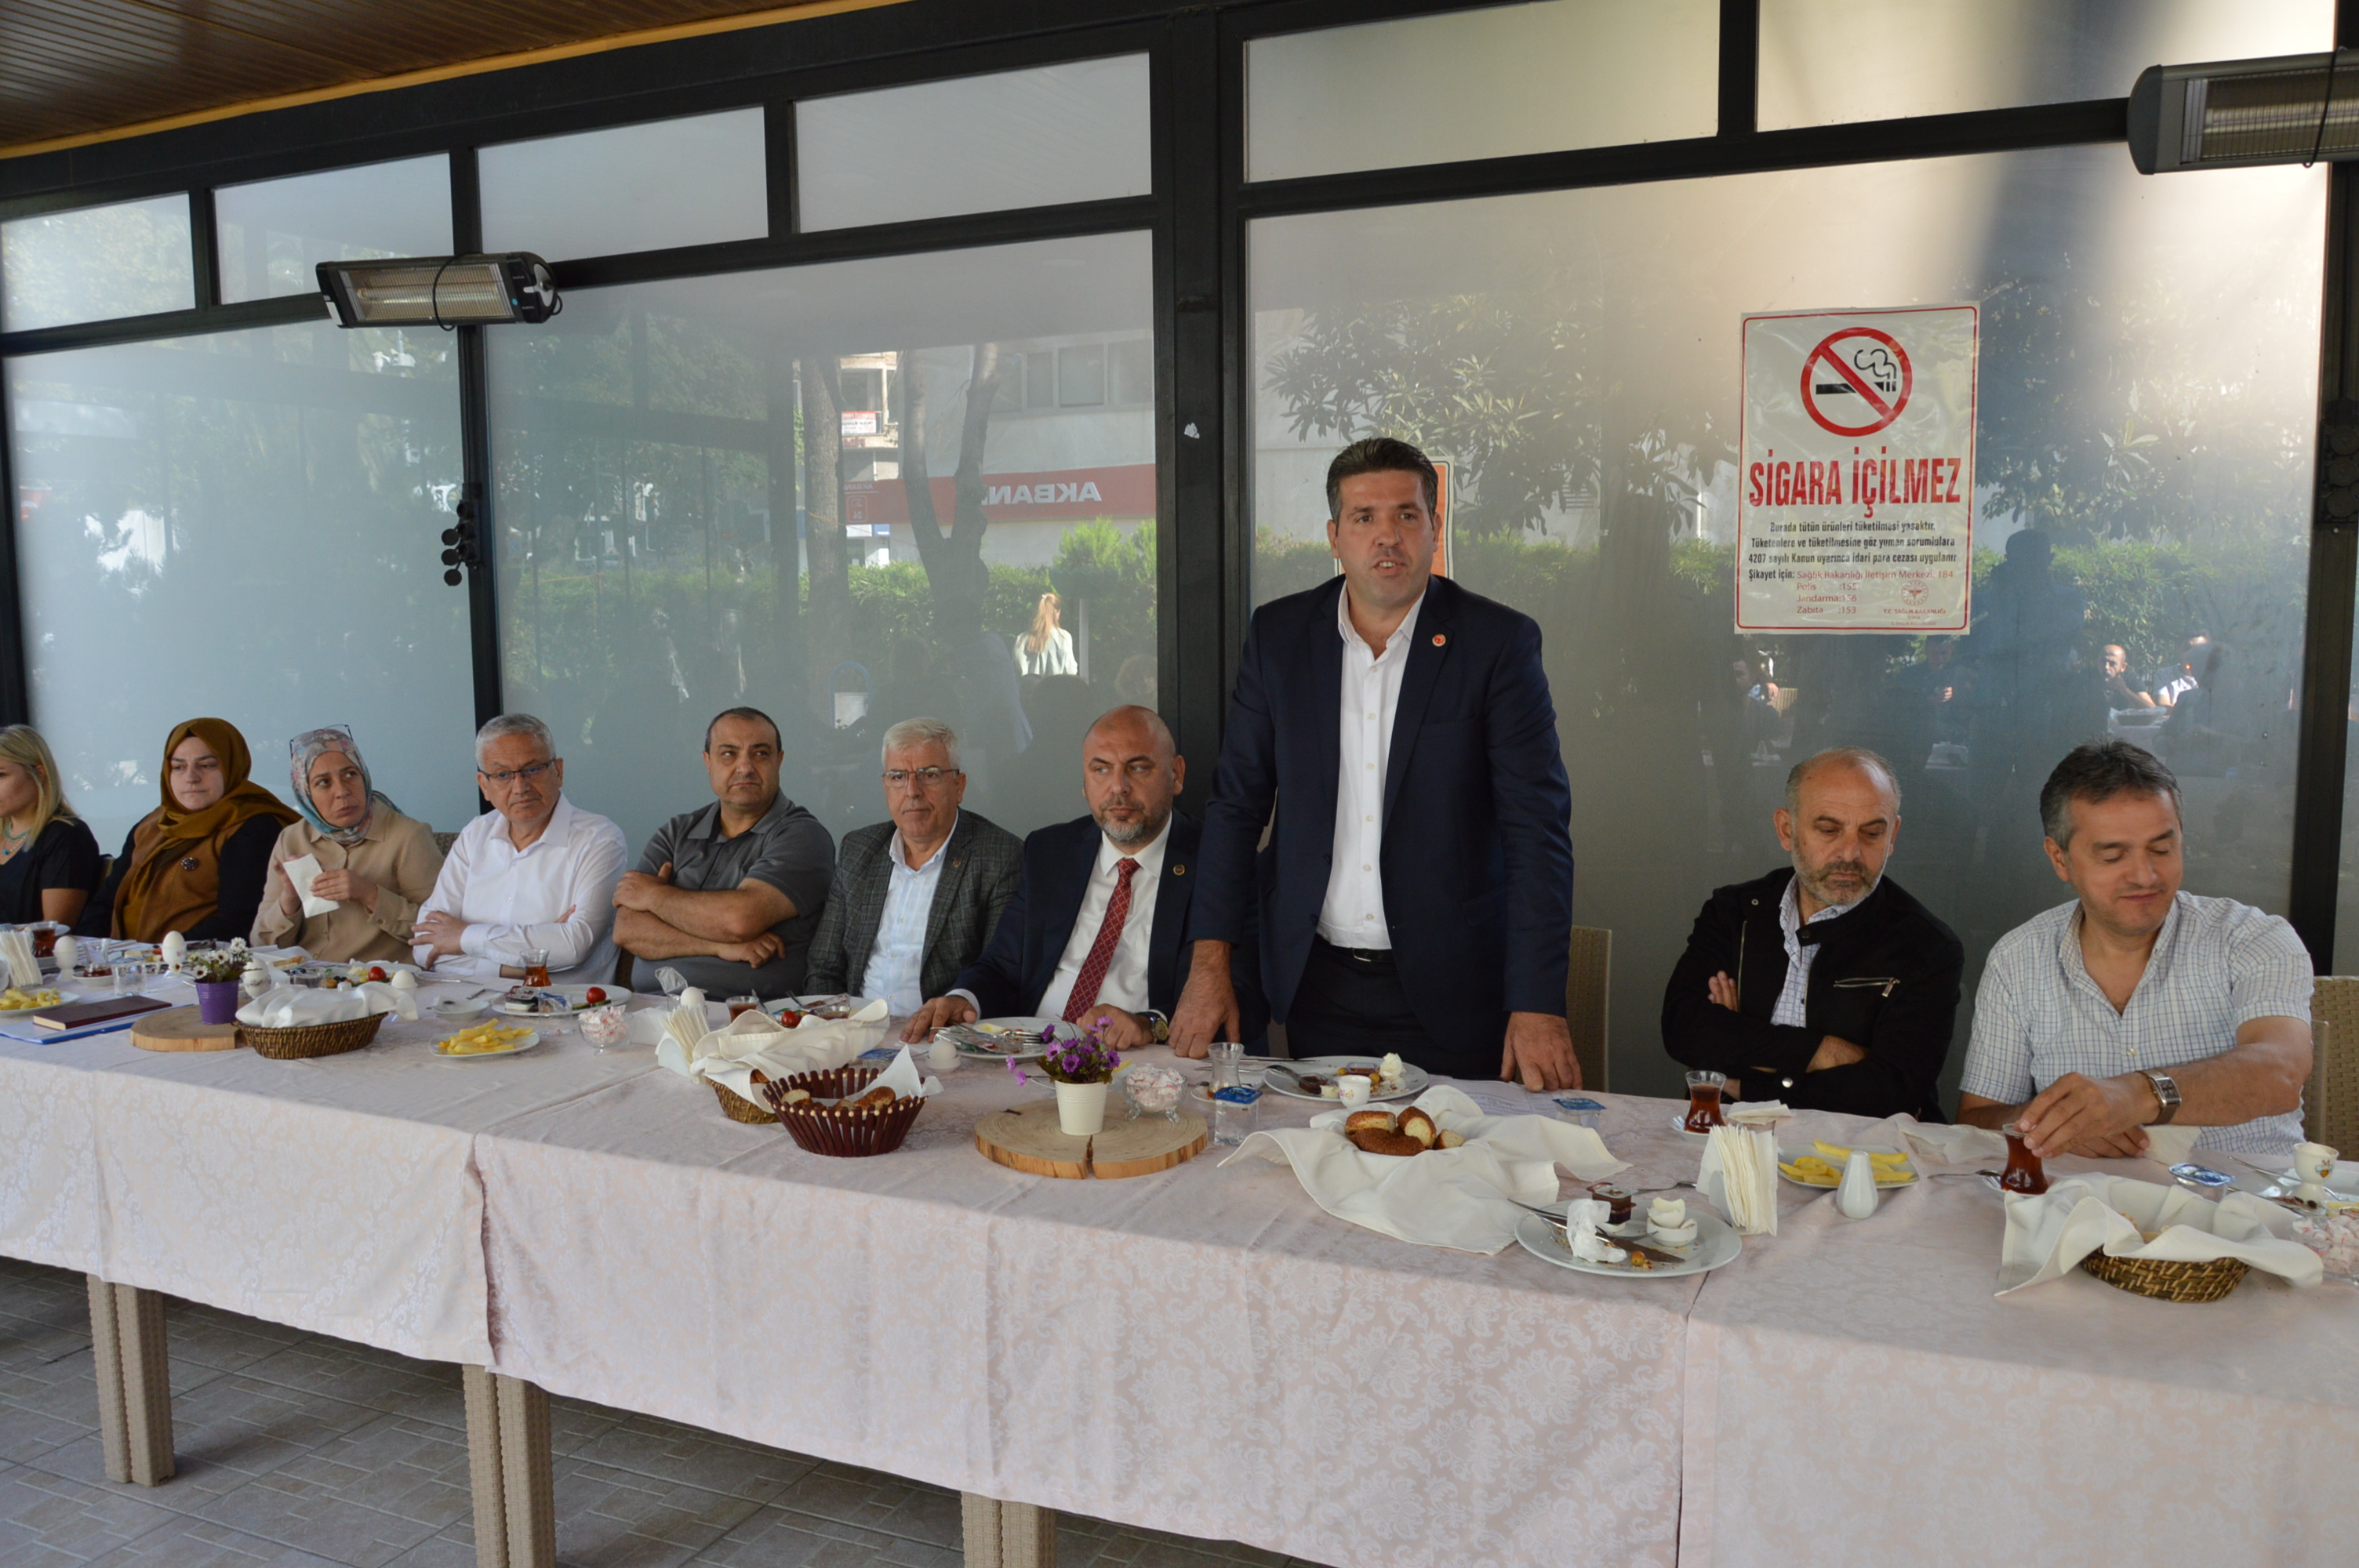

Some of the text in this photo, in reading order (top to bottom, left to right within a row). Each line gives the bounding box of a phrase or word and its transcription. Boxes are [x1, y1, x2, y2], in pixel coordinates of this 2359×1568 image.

[1749, 446, 1961, 518] SİGARA İÇİLMEZ
[1770, 520, 1936, 533] Burada tütün ürünleri tüketilmesi yasaktır.
[1751, 537, 1795, 548] Tüketenlere
[1808, 537, 1862, 547] tüketilmesine
[1863, 537, 1877, 549] göz
[1879, 538, 1905, 549] yuman
[1906, 536, 1955, 546] sorumlulara
[1748, 552, 1957, 565] 4207 sayılı Kanun uyarınca idari para cezası uygulanır
[1748, 568, 1776, 581] Şikayet
[1778, 568, 1795, 581] için:
[1797, 571, 1823, 580] Sağlık
[1824, 571, 1863, 580] Bakanlığı
[1865, 569, 1896, 580] İletişim
[1797, 605, 1823, 614] Zabıta
